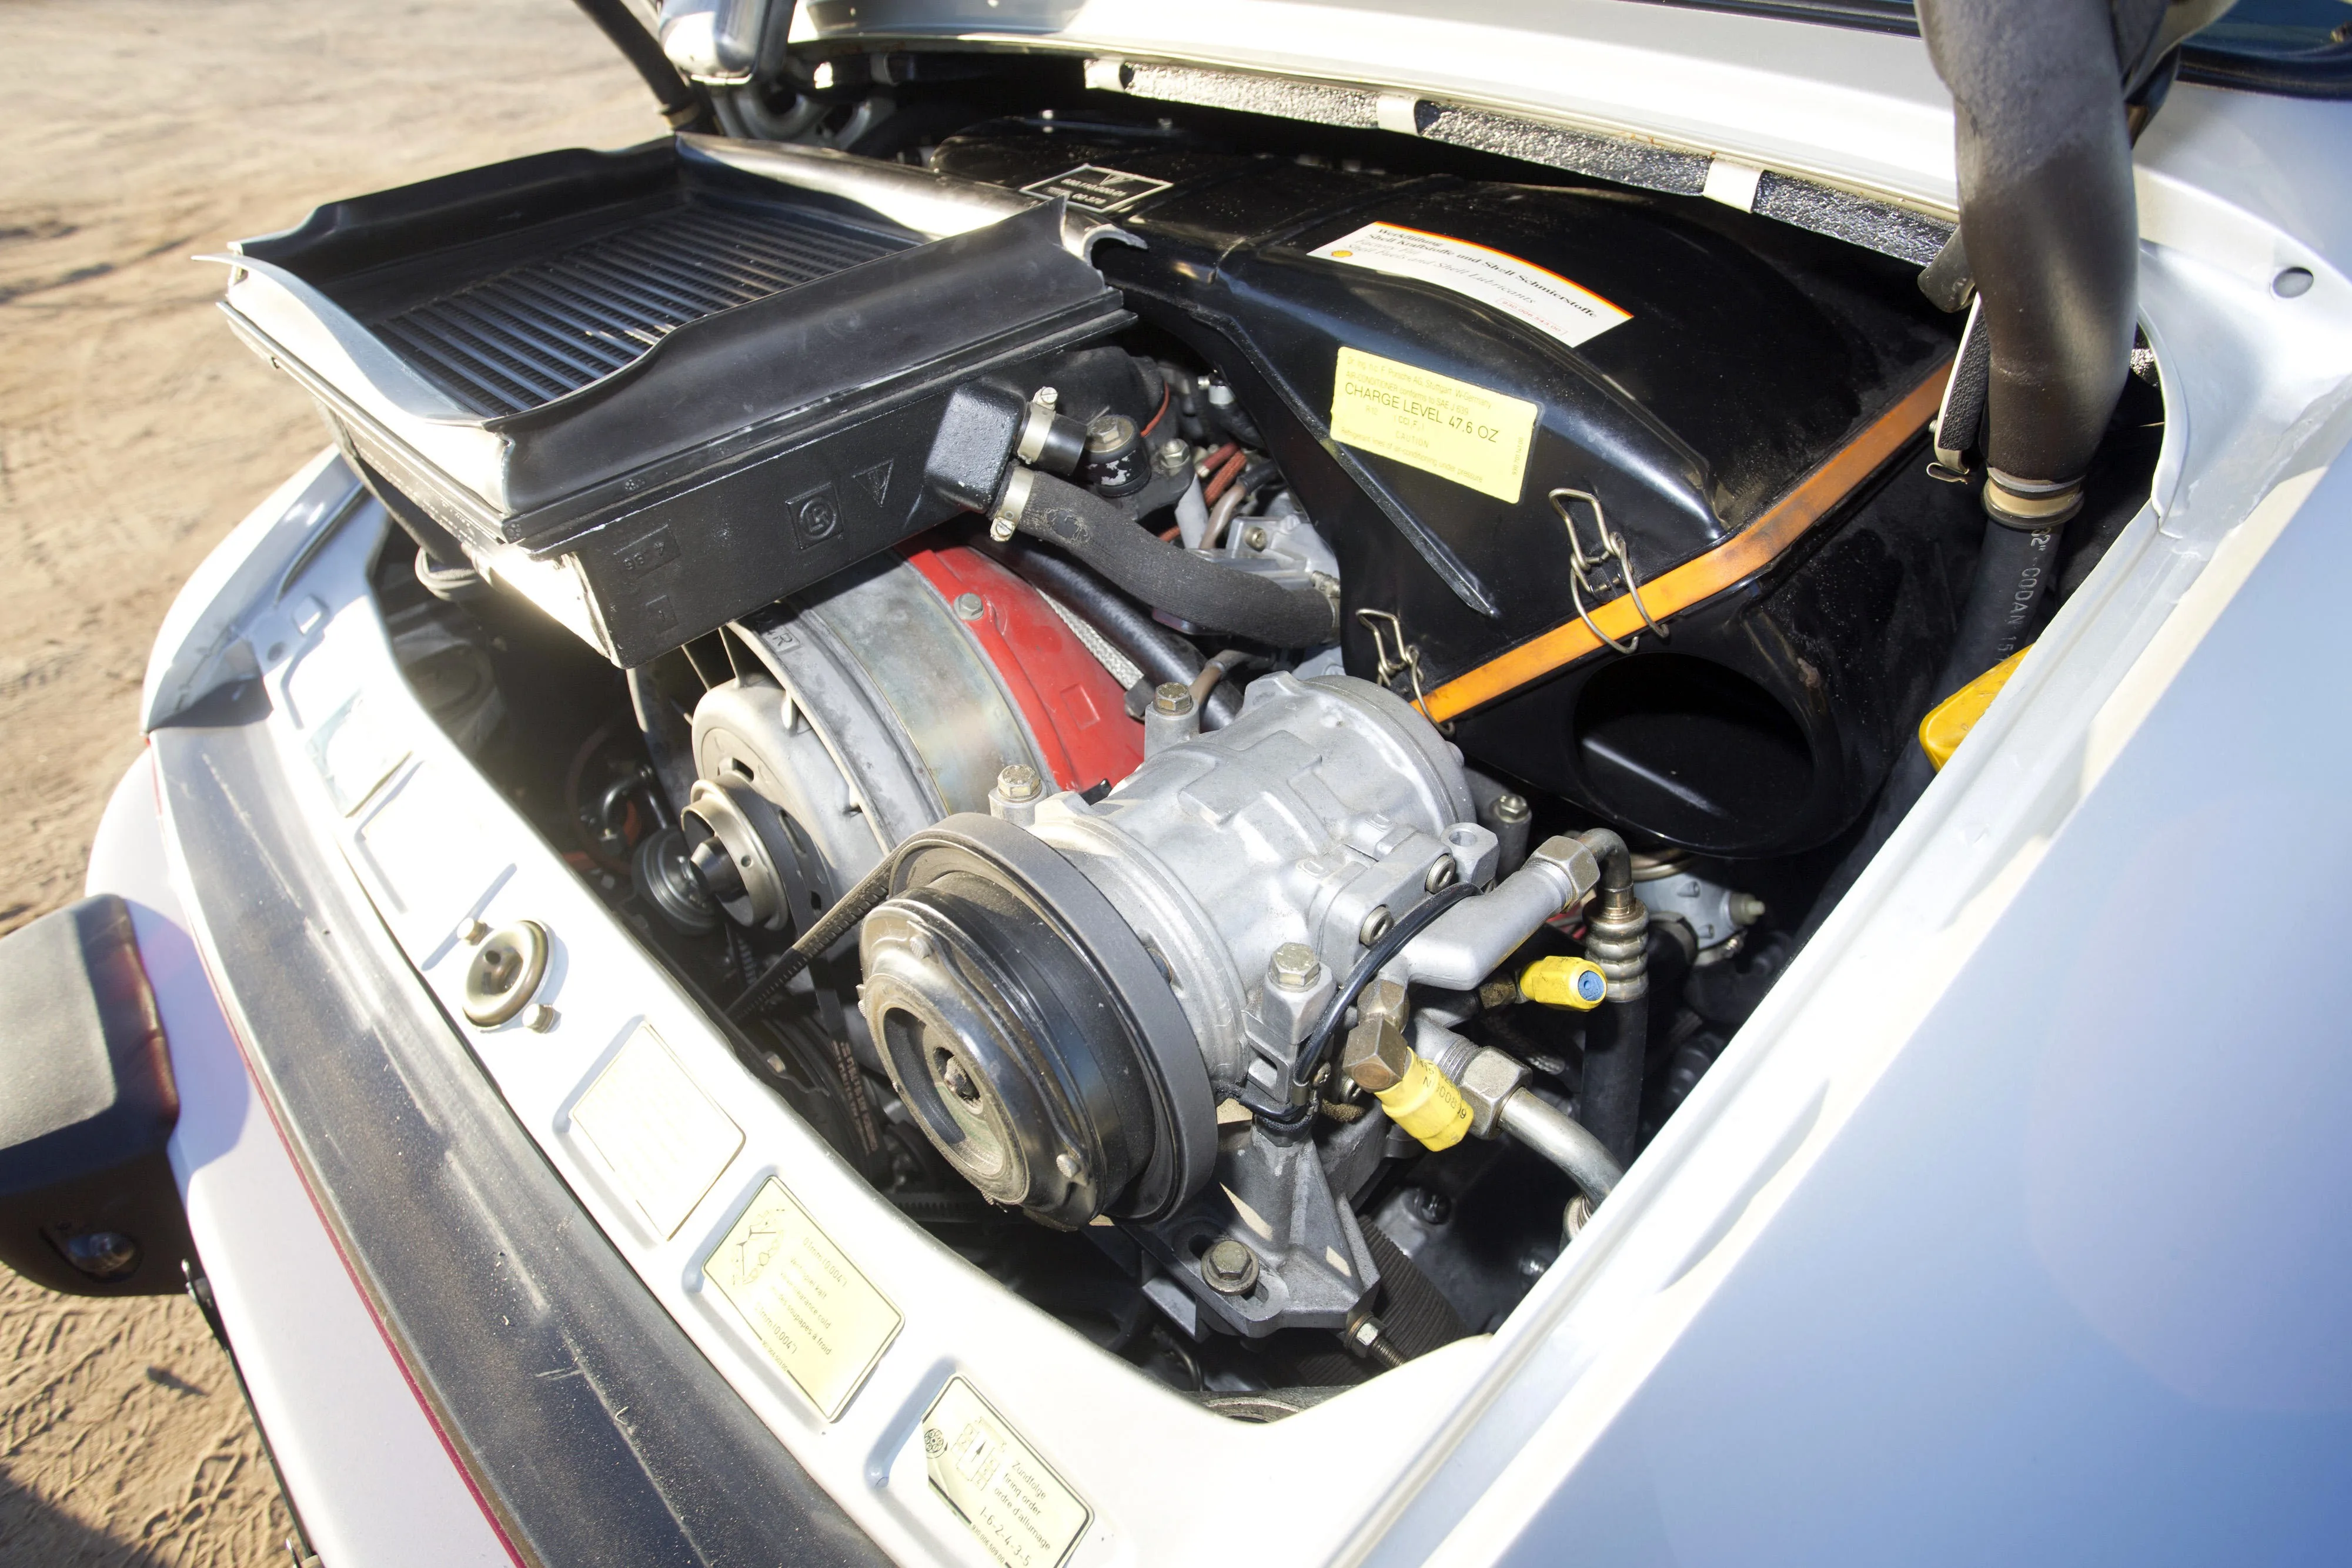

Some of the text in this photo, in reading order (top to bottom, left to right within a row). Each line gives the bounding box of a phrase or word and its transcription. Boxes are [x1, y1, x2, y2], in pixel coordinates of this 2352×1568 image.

[1368, 233, 1598, 319] Shell Kraftstoffe und Shell Schmierstoffe
[1406, 258, 1435, 268] and
[1435, 260, 1468, 277] Shell
[1468, 272, 1537, 305] Lubricants
[1345, 382, 1499, 443] CHARGE LEVEL 47.6 OZ
[1428, 395, 1435, 404] to
[1436, 399, 1449, 409] SAE
[1455, 404, 1469, 416] 639
[1395, 431, 1429, 447] CAUTION
[1439, 462, 1455, 472] under
[1457, 469, 1482, 483] pressure
[2006, 567, 2040, 624] CODAN
[815, 1285, 827, 1300] kalt
[786, 1303, 813, 1335] soupapes
[816, 1337, 832, 1355] froid
[817, 1313, 831, 1329] cold
[1003, 1473, 1041, 1515] firing order
[994, 1487, 1051, 1550] ordre d'allumage
